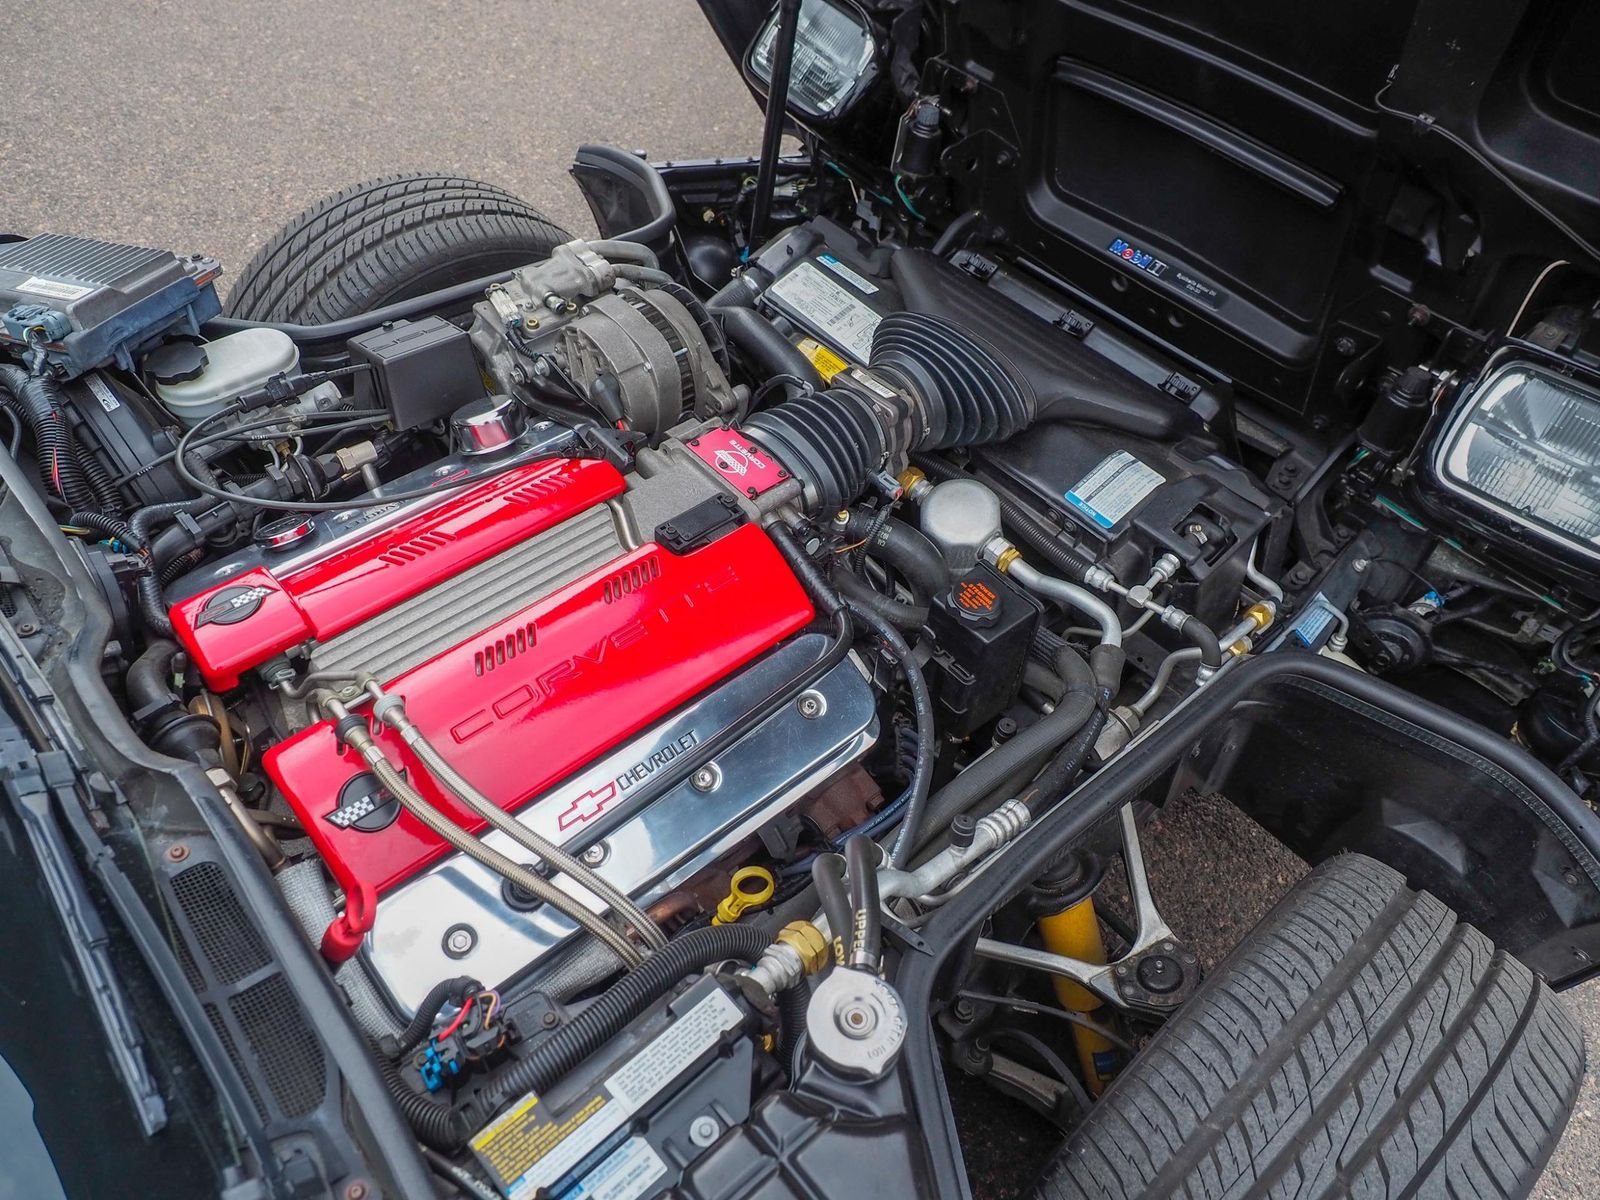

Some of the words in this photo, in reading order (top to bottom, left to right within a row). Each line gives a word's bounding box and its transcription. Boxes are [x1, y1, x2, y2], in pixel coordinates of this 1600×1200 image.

[1109, 239, 1152, 269] Mobil
[729, 440, 766, 469] CORVETTE
[450, 564, 739, 744] CORVETTE
[617, 729, 700, 790] CHEVROLET
[853, 909, 867, 952] UPPE
